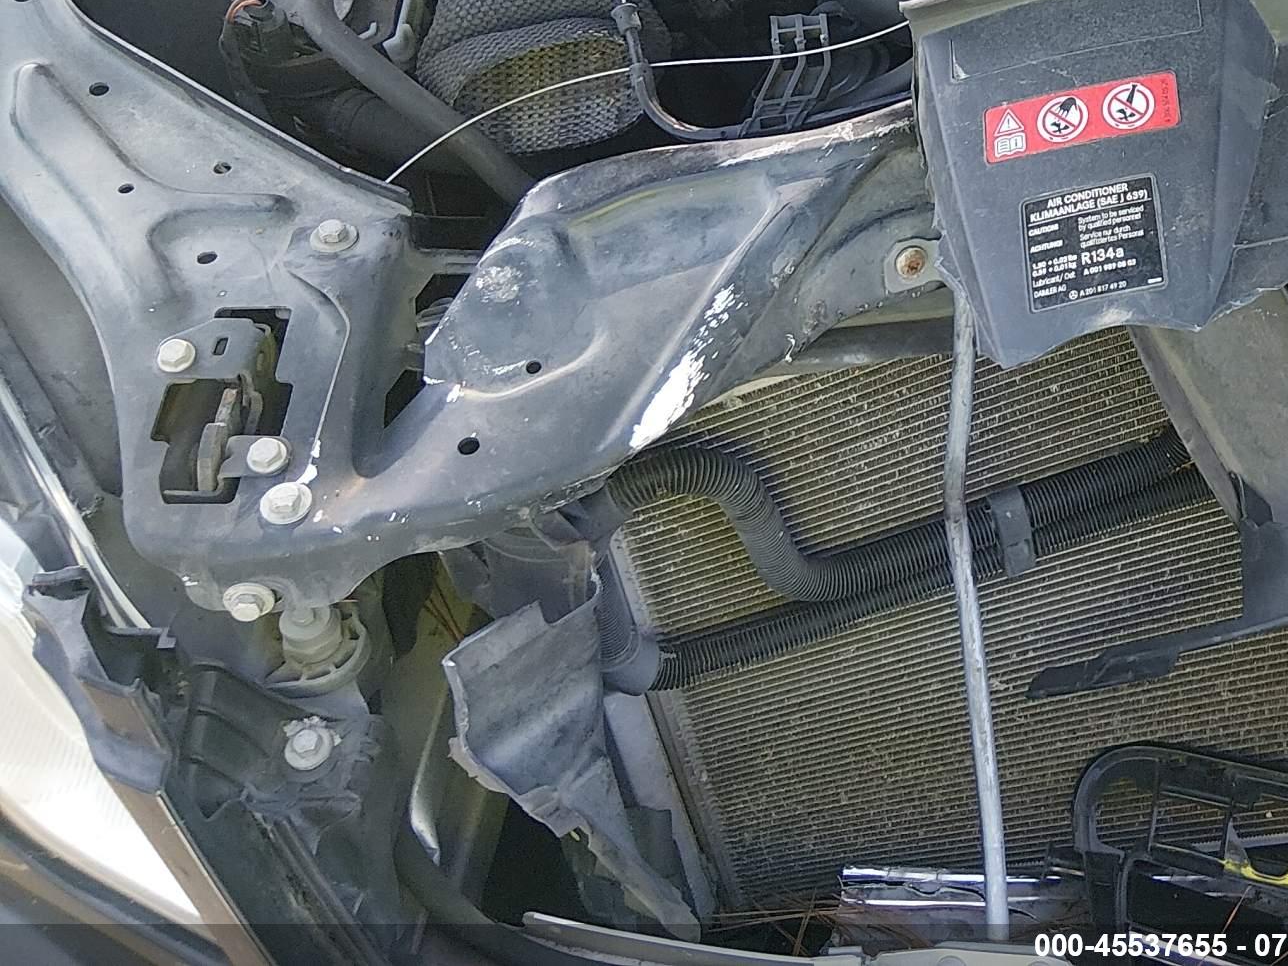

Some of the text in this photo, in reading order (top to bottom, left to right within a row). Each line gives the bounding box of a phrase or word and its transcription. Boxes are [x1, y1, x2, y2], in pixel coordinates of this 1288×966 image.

[1047, 183, 1129, 209] AIR CONDITIONER
[1030, 200, 1096, 223] KLIMAANLAGE
[1097, 194, 1119, 210] (SAE
[1120, 193, 1125, 204] J
[1078, 214, 1101, 225] System
[1118, 204, 1144, 216] serviced
[1079, 231, 1103, 241] Service
[1081, 246, 1125, 266] R134a
[1083, 268, 1090, 276] A
